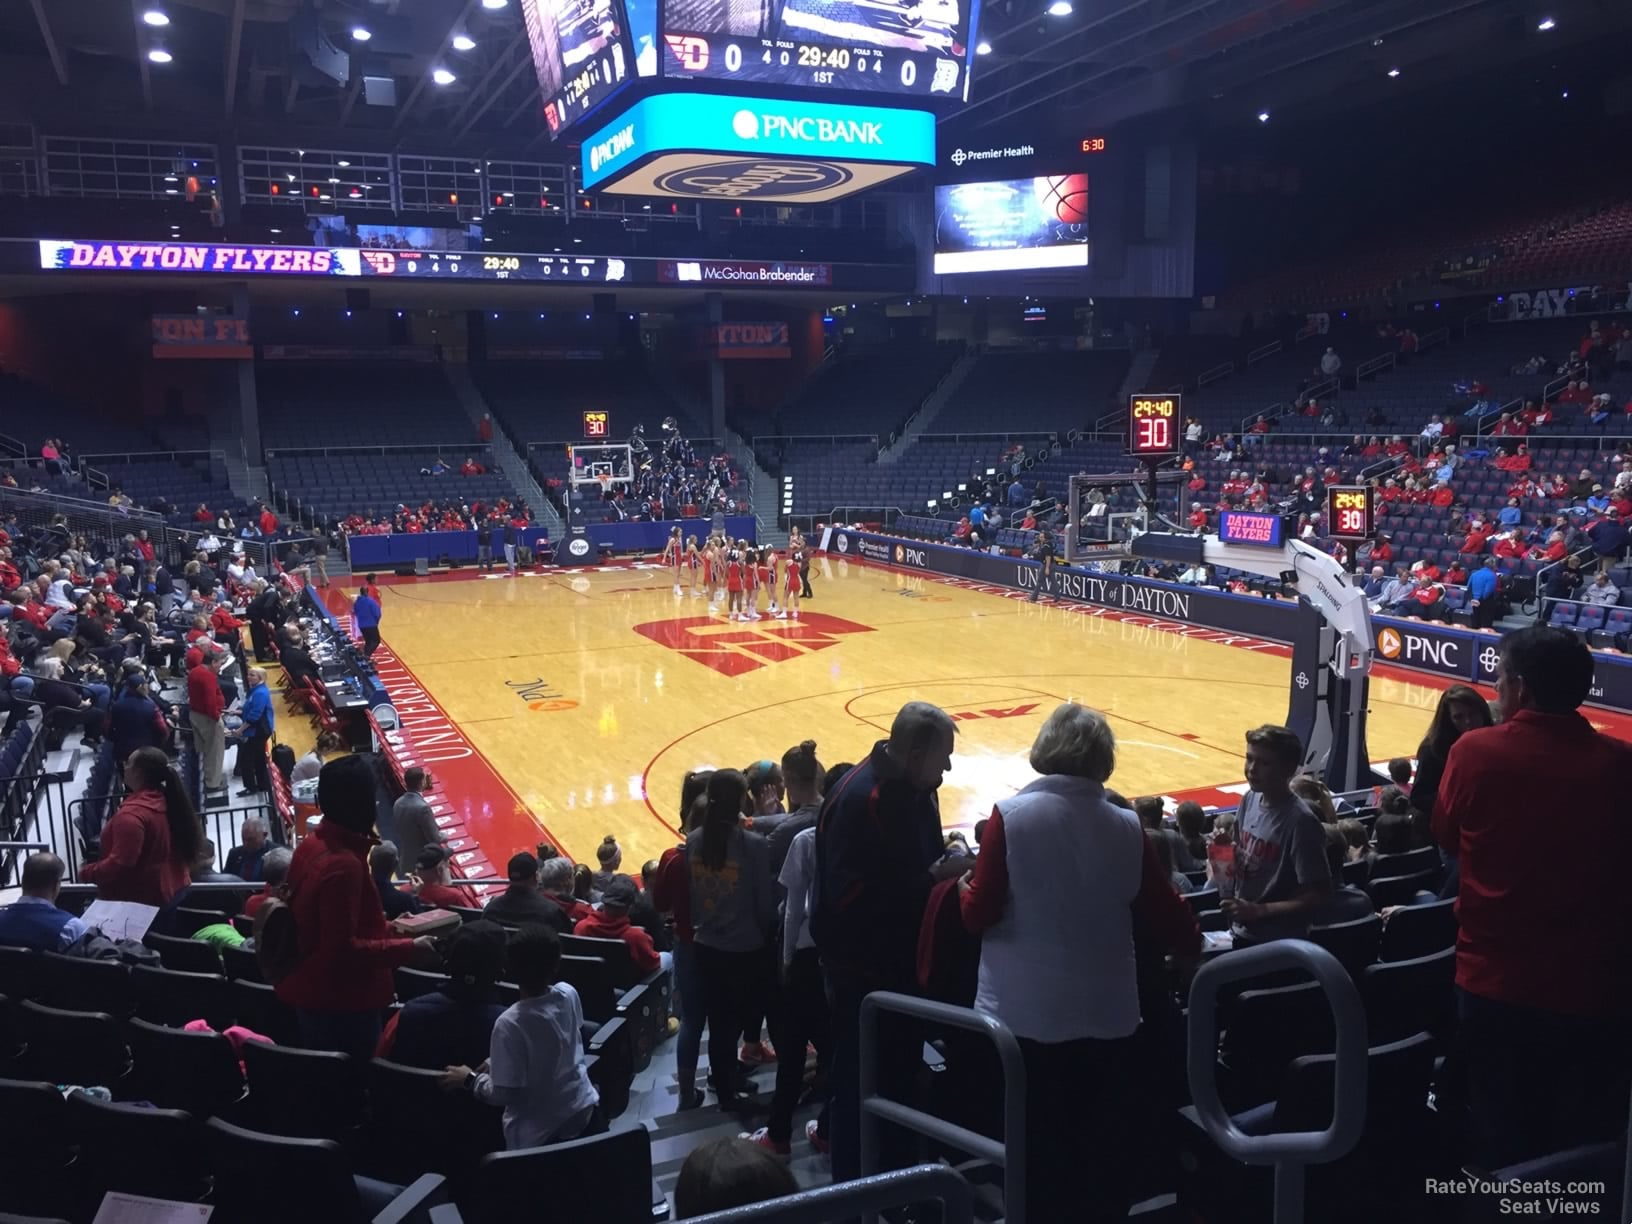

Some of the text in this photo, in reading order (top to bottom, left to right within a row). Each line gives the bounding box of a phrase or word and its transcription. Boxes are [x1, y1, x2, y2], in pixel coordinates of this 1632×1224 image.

[761, 39, 794, 49] TOL FOULS
[853, 47, 871, 56] FOULS
[724, 44, 742, 72] 0
[762, 50, 789, 66] 4 0
[797, 45, 850, 70] 29:40
[857, 57, 882, 73] 0 4
[813, 71, 834, 84] 1ST
[900, 59, 916, 86] 0
[967, 144, 1034, 161] Premier Health
[1082, 138, 1105, 151] 6:30
[70, 242, 333, 273] DAYTON FLYERS
[483, 256, 519, 270] 29:40
[407, 260, 458, 272] 0 4 0
[543, 265, 590, 277] 0 4 0
[496, 271, 508, 279] 1ST
[1134, 400, 1173, 417] 29:40
[589, 421, 604, 435] 30
[1139, 418, 1168, 448] 30
[1335, 493, 1364, 509] 29:40
[1226, 514, 1274, 530] DAYTON
[1341, 510, 1361, 530] 30
[1227, 526, 1271, 542] FLYERS
[906, 548, 925, 566] PNC
[1109, 586, 1118, 602] of
[1121, 583, 1190, 618] DAYTON
[1316, 581, 1343, 612] SPALDING
[1404, 634, 1458, 668] PNC
